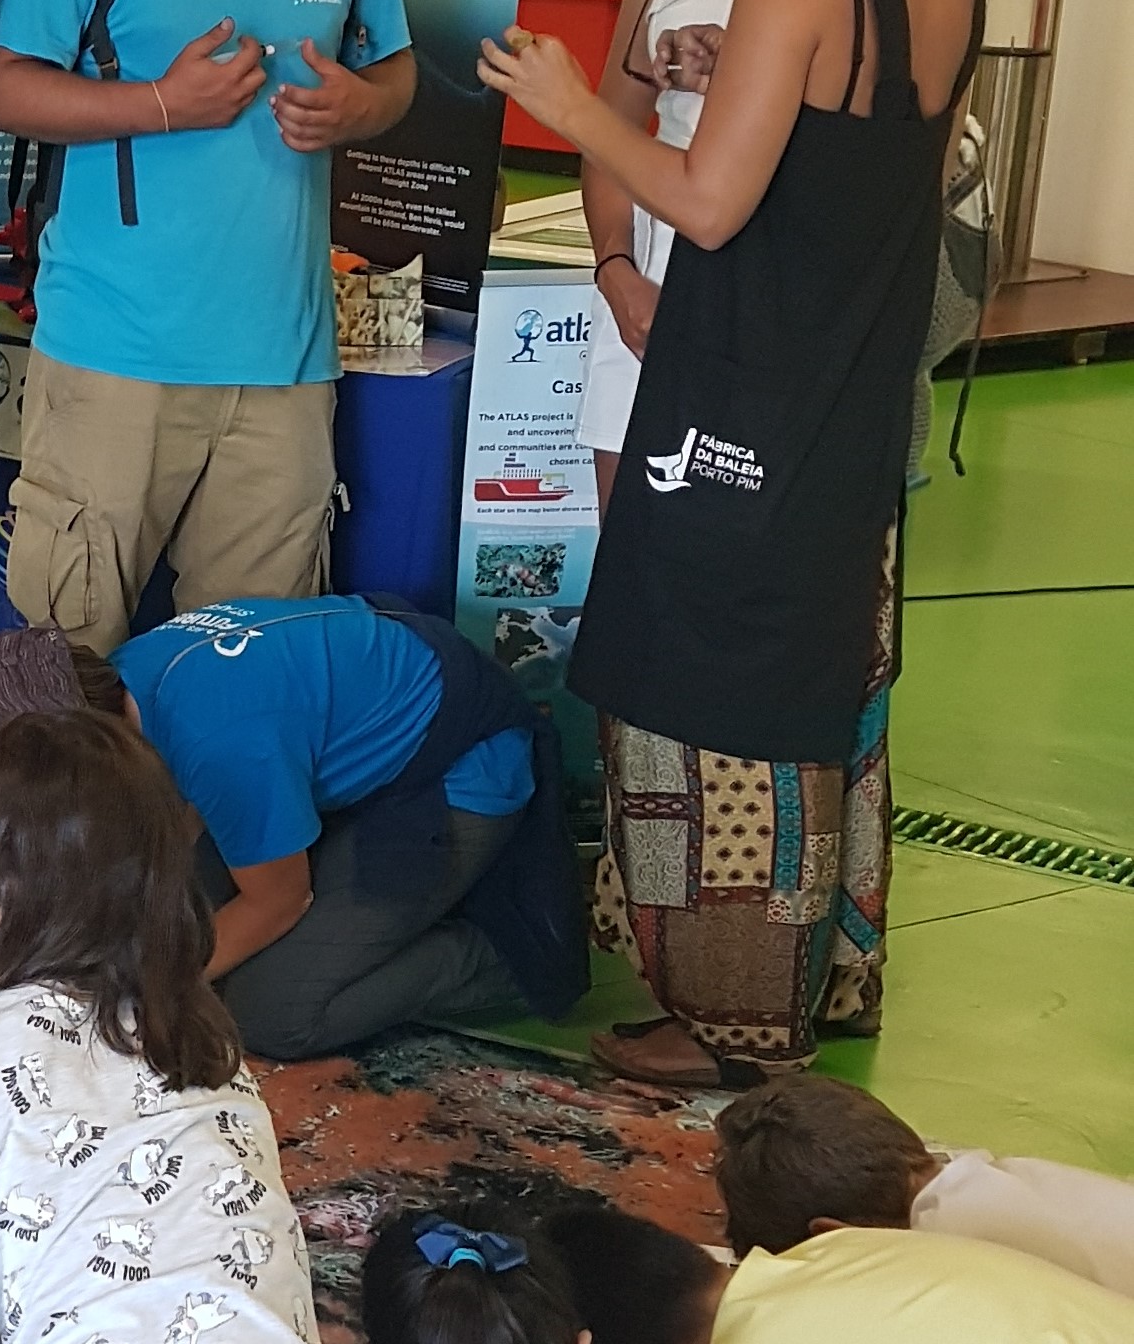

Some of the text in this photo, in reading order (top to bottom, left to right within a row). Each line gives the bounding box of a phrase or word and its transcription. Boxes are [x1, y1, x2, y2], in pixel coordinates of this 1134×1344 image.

[383, 166, 405, 176] ATLAS
[457, 166, 470, 176] The
[410, 180, 428, 192] Zone
[406, 202, 422, 212] even
[423, 204, 435, 214] the
[408, 212, 422, 223] Ben
[444, 220, 466, 230] would
[546, 312, 591, 344] atl
[479, 412, 574, 422] The ATLAS project is
[508, 428, 525, 436] and
[498, 443, 556, 452] communities
[550, 458, 580, 466] chosen
[695, 448, 764, 478] DA BALEIA
[690, 461, 762, 492] PORTO PIM
[26, 1014, 56, 1036] YOGA
[70, 1143, 100, 1168] YOGA
[142, 1178, 172, 1206] YOGA
[222, 1178, 268, 1218] COOL YOGA
[123, 1264, 150, 1282] COOL
[230, 1269, 258, 1290] COOL
